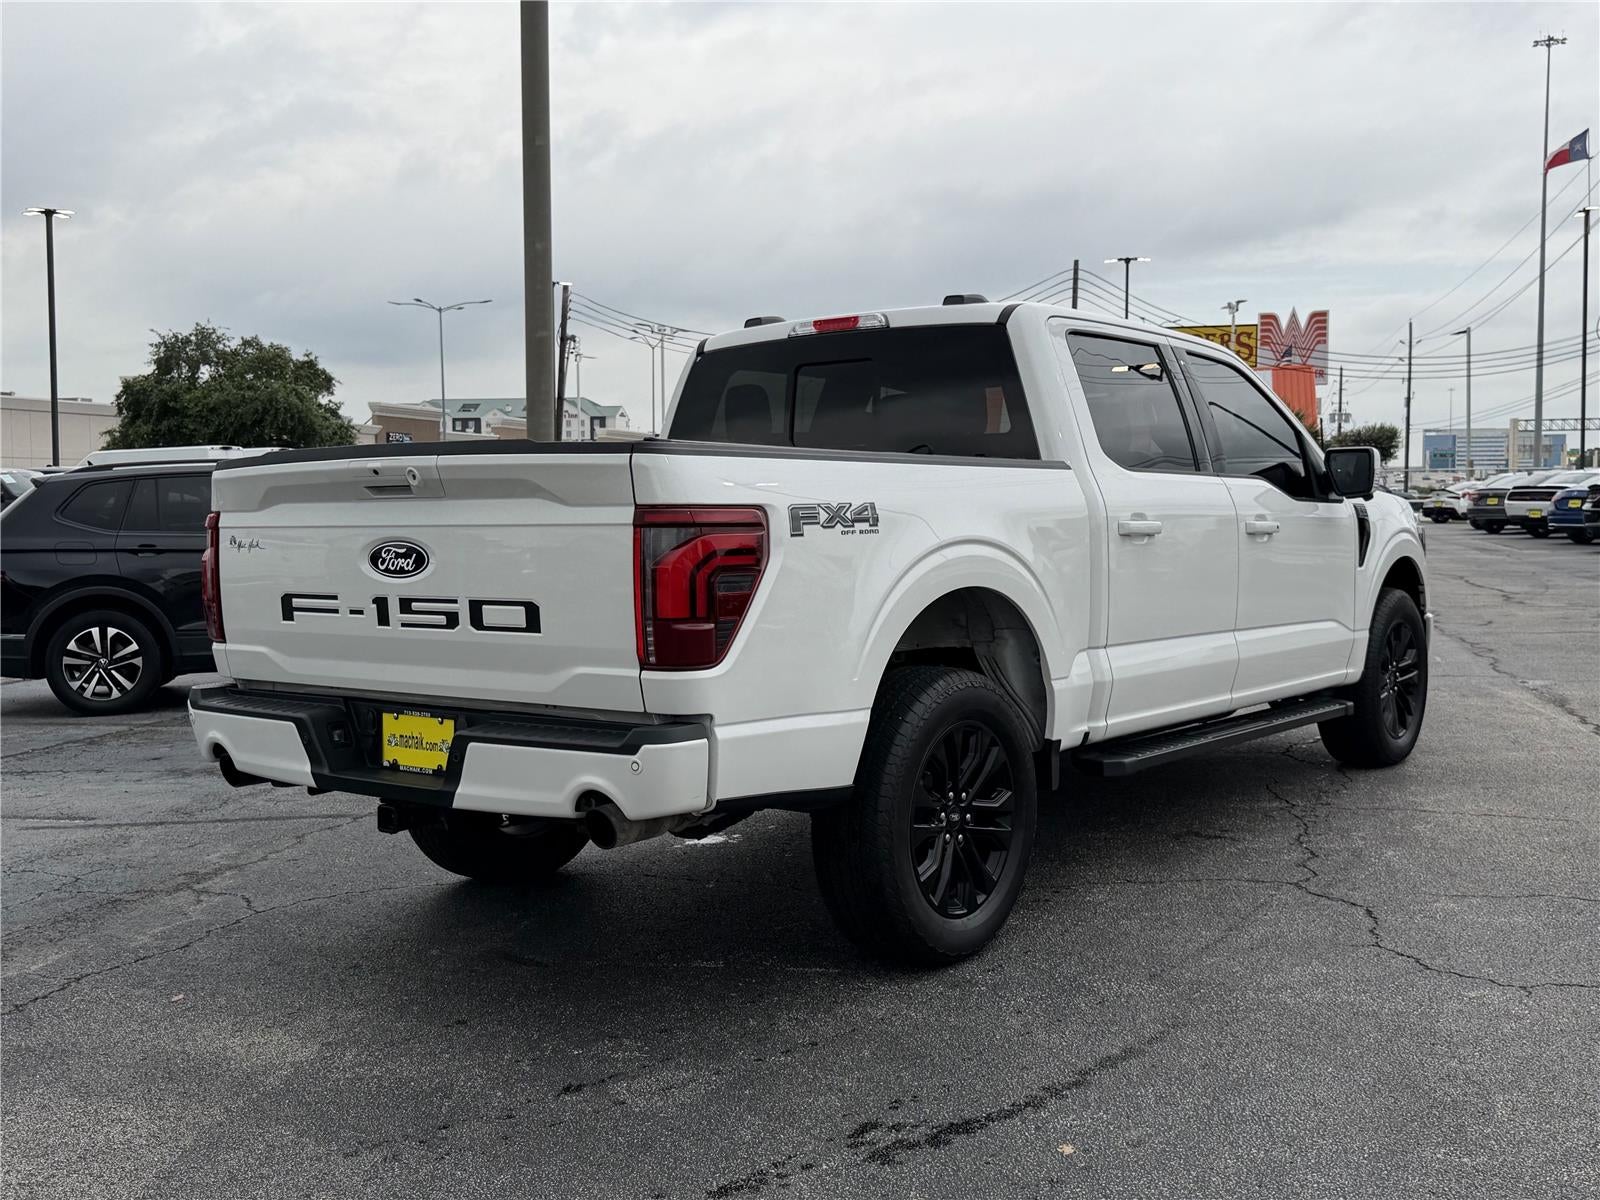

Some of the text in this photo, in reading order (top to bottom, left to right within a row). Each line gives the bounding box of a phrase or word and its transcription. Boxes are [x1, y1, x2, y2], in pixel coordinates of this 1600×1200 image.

[788, 502, 879, 537] FX4
[378, 546, 416, 571] Ford
[280, 593, 542, 634] F-150
